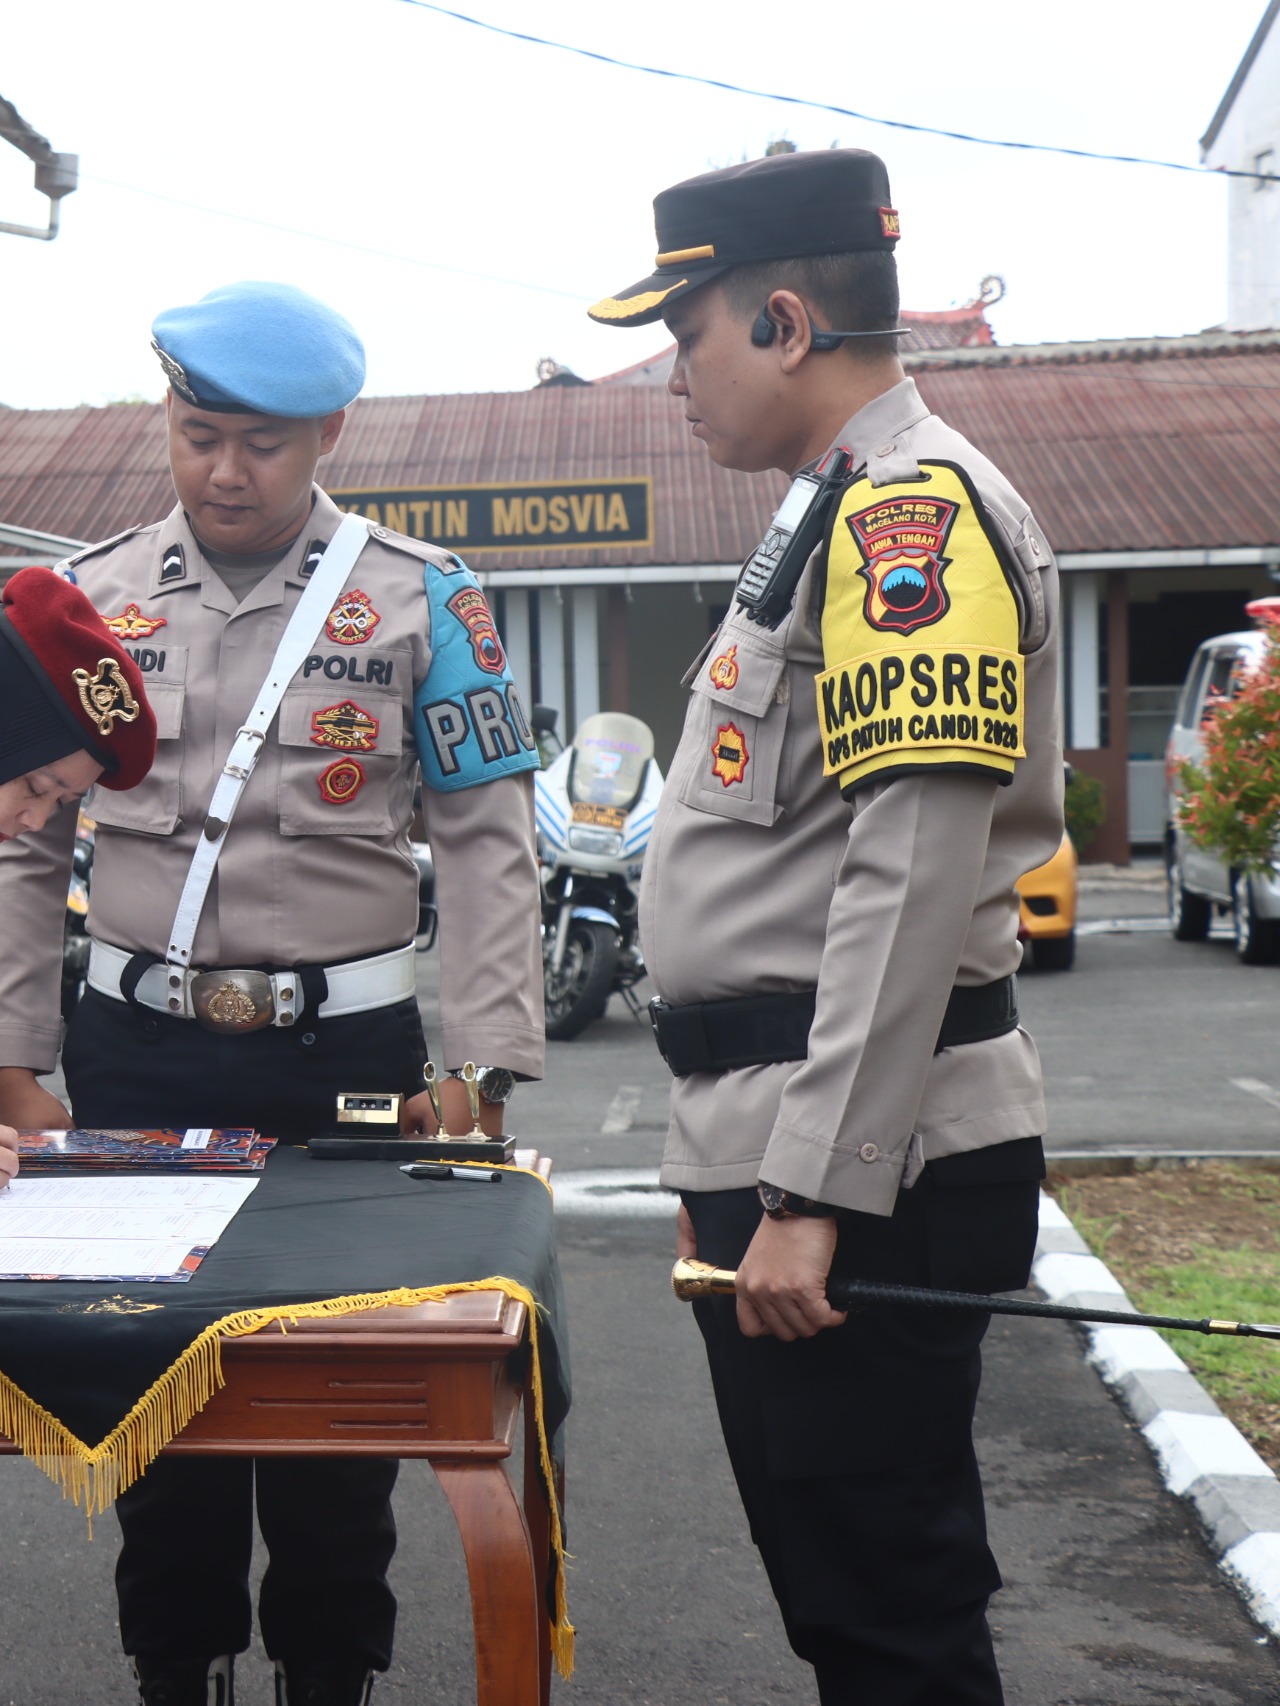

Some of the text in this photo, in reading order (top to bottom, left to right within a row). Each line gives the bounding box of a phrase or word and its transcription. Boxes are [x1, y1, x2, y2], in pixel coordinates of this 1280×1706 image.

[492, 492, 630, 537] MOSVIA
[864, 504, 937, 524] POLRES
[866, 513, 937, 533] MAGELANG KOTA
[870, 533, 936, 554] JAWA TENGAH
[303, 654, 394, 686] POLRI
[821, 653, 1018, 734] KAOPSRES
[828, 733, 851, 767] OPS
[851, 716, 903, 756] PATUH
[908, 714, 978, 741] CANDI
